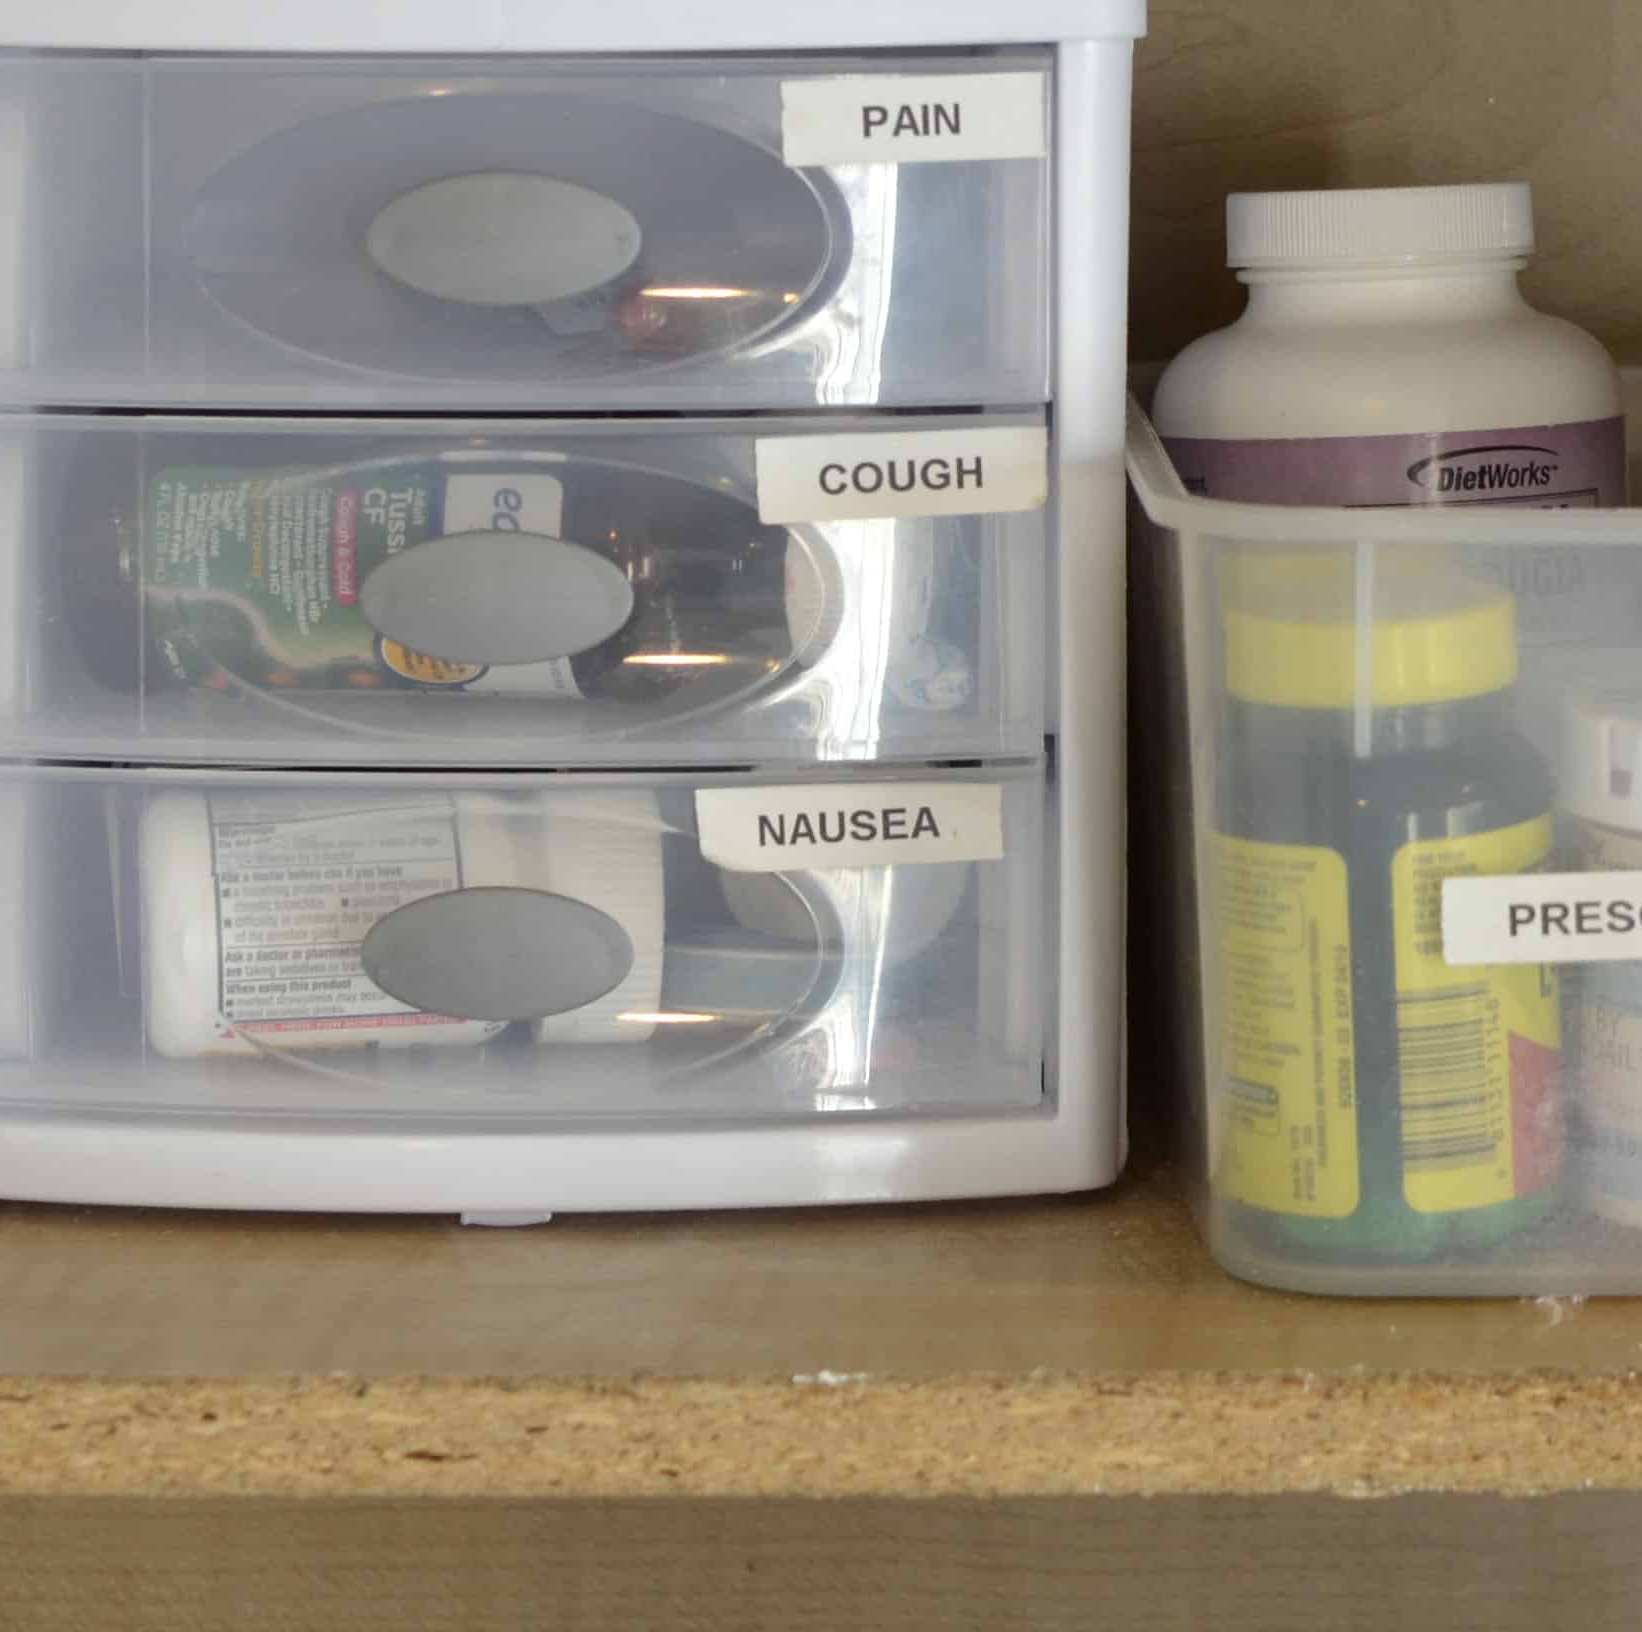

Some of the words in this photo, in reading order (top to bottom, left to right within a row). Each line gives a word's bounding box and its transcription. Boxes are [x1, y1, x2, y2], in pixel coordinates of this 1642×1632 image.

[862, 102, 961, 137] PAIN
[818, 455, 986, 496] COUGH
[1437, 461, 1551, 492] DietWorks
[363, 487, 387, 526] CF
[339, 558, 354, 596] Cold
[758, 805, 941, 848] NAUSEA
